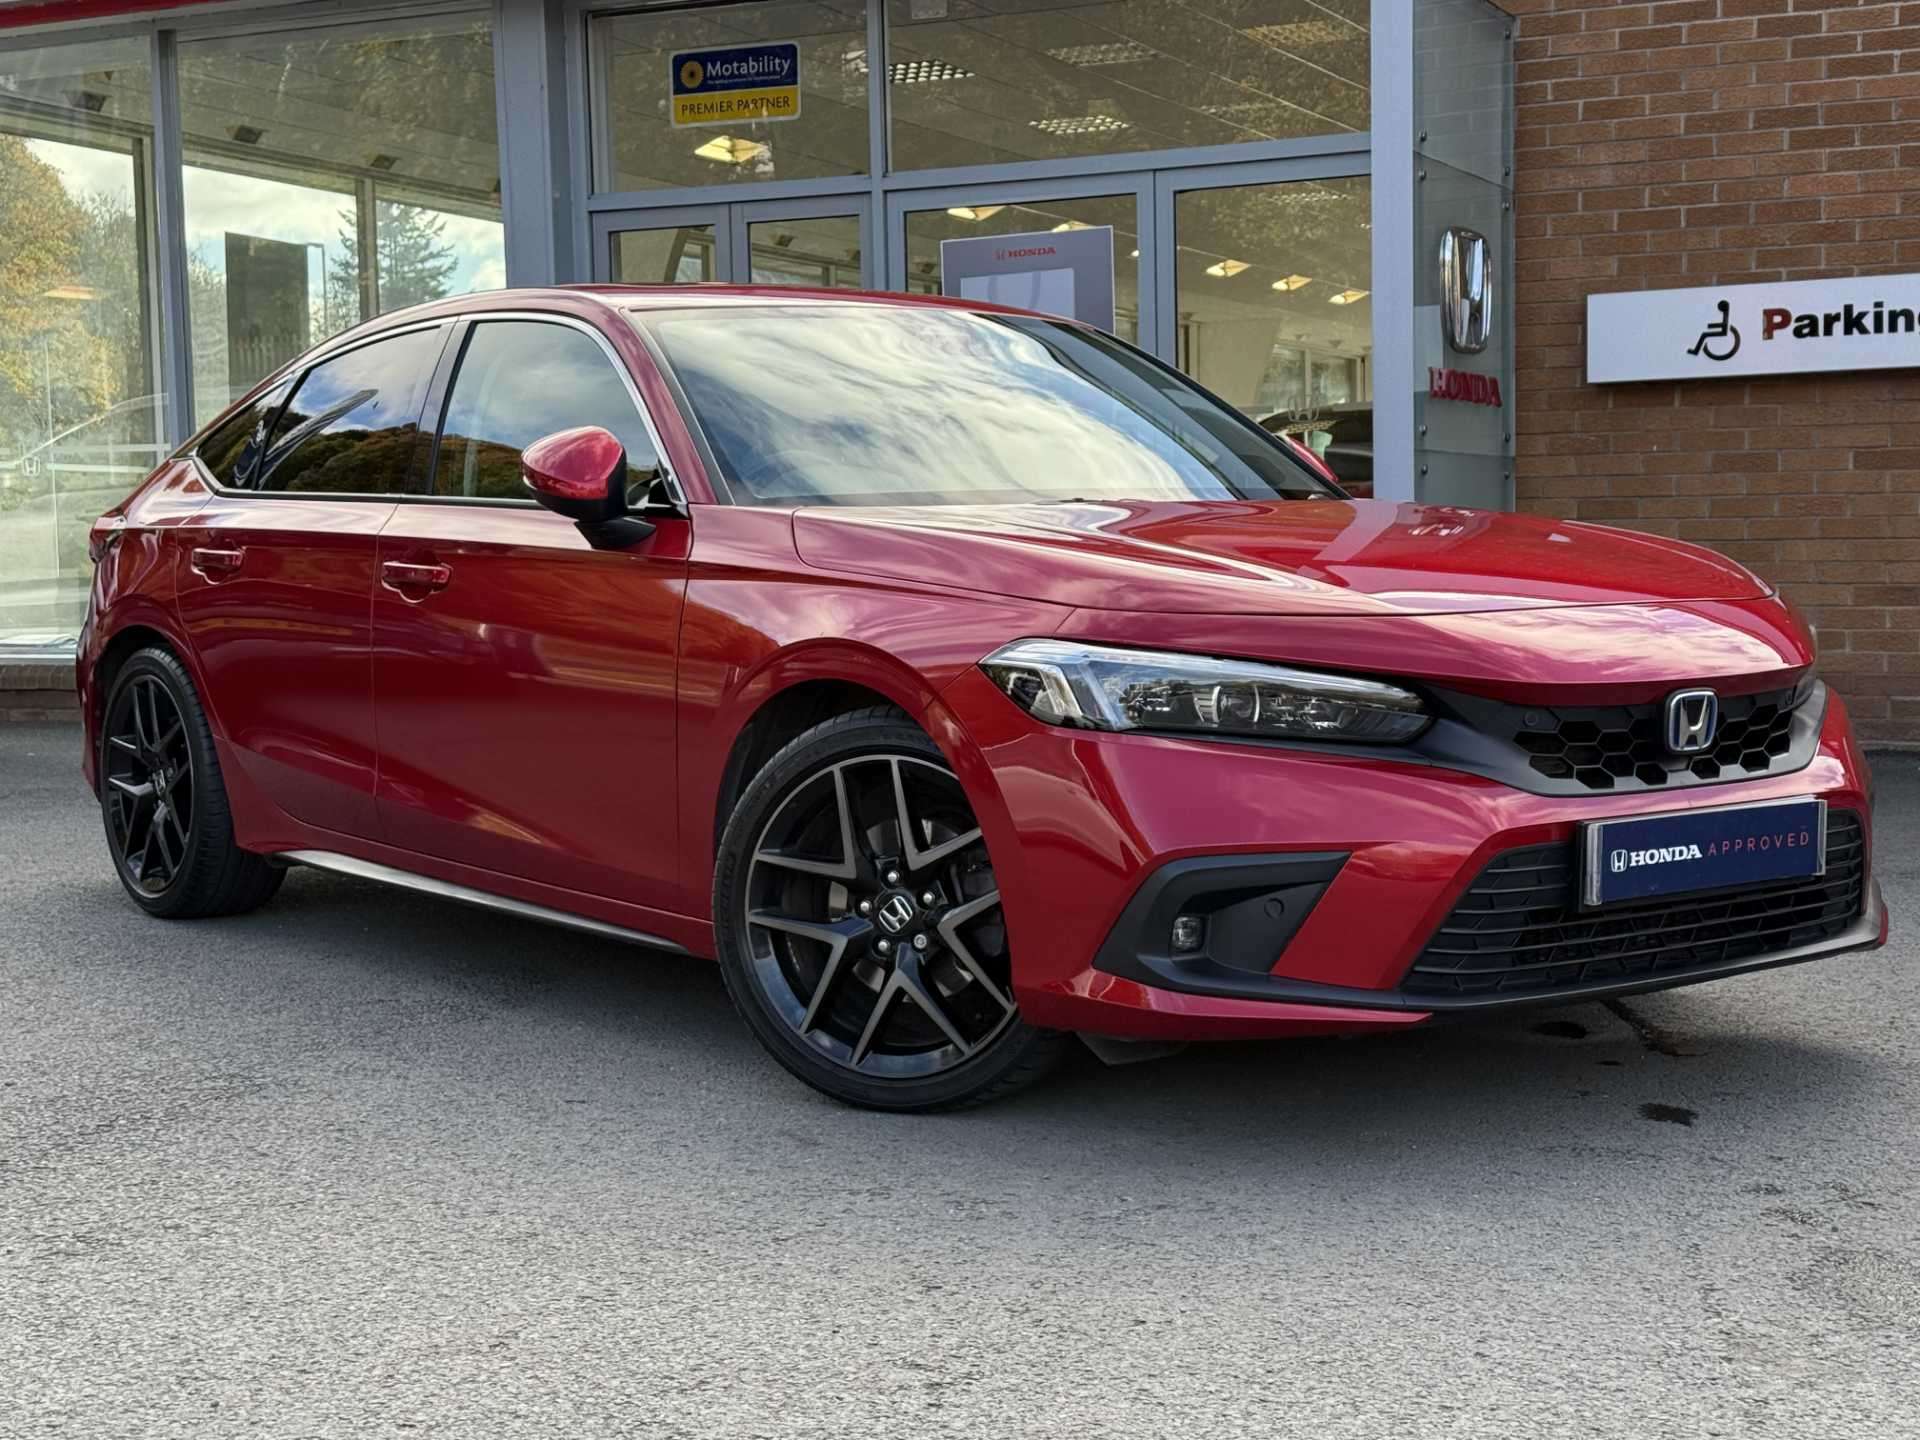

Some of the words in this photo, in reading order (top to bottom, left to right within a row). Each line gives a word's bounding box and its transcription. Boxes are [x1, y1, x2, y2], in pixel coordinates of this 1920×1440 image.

[706, 55, 791, 78] Motability
[681, 100, 733, 115] PREMIER
[737, 96, 790, 111] PARTNER
[1007, 246, 1056, 257] HONDA
[1762, 301, 1920, 341] Parkin
[1428, 367, 1502, 408] HONDA
[1629, 844, 1703, 867] HONDA
[1707, 831, 1810, 857] APPROVED
